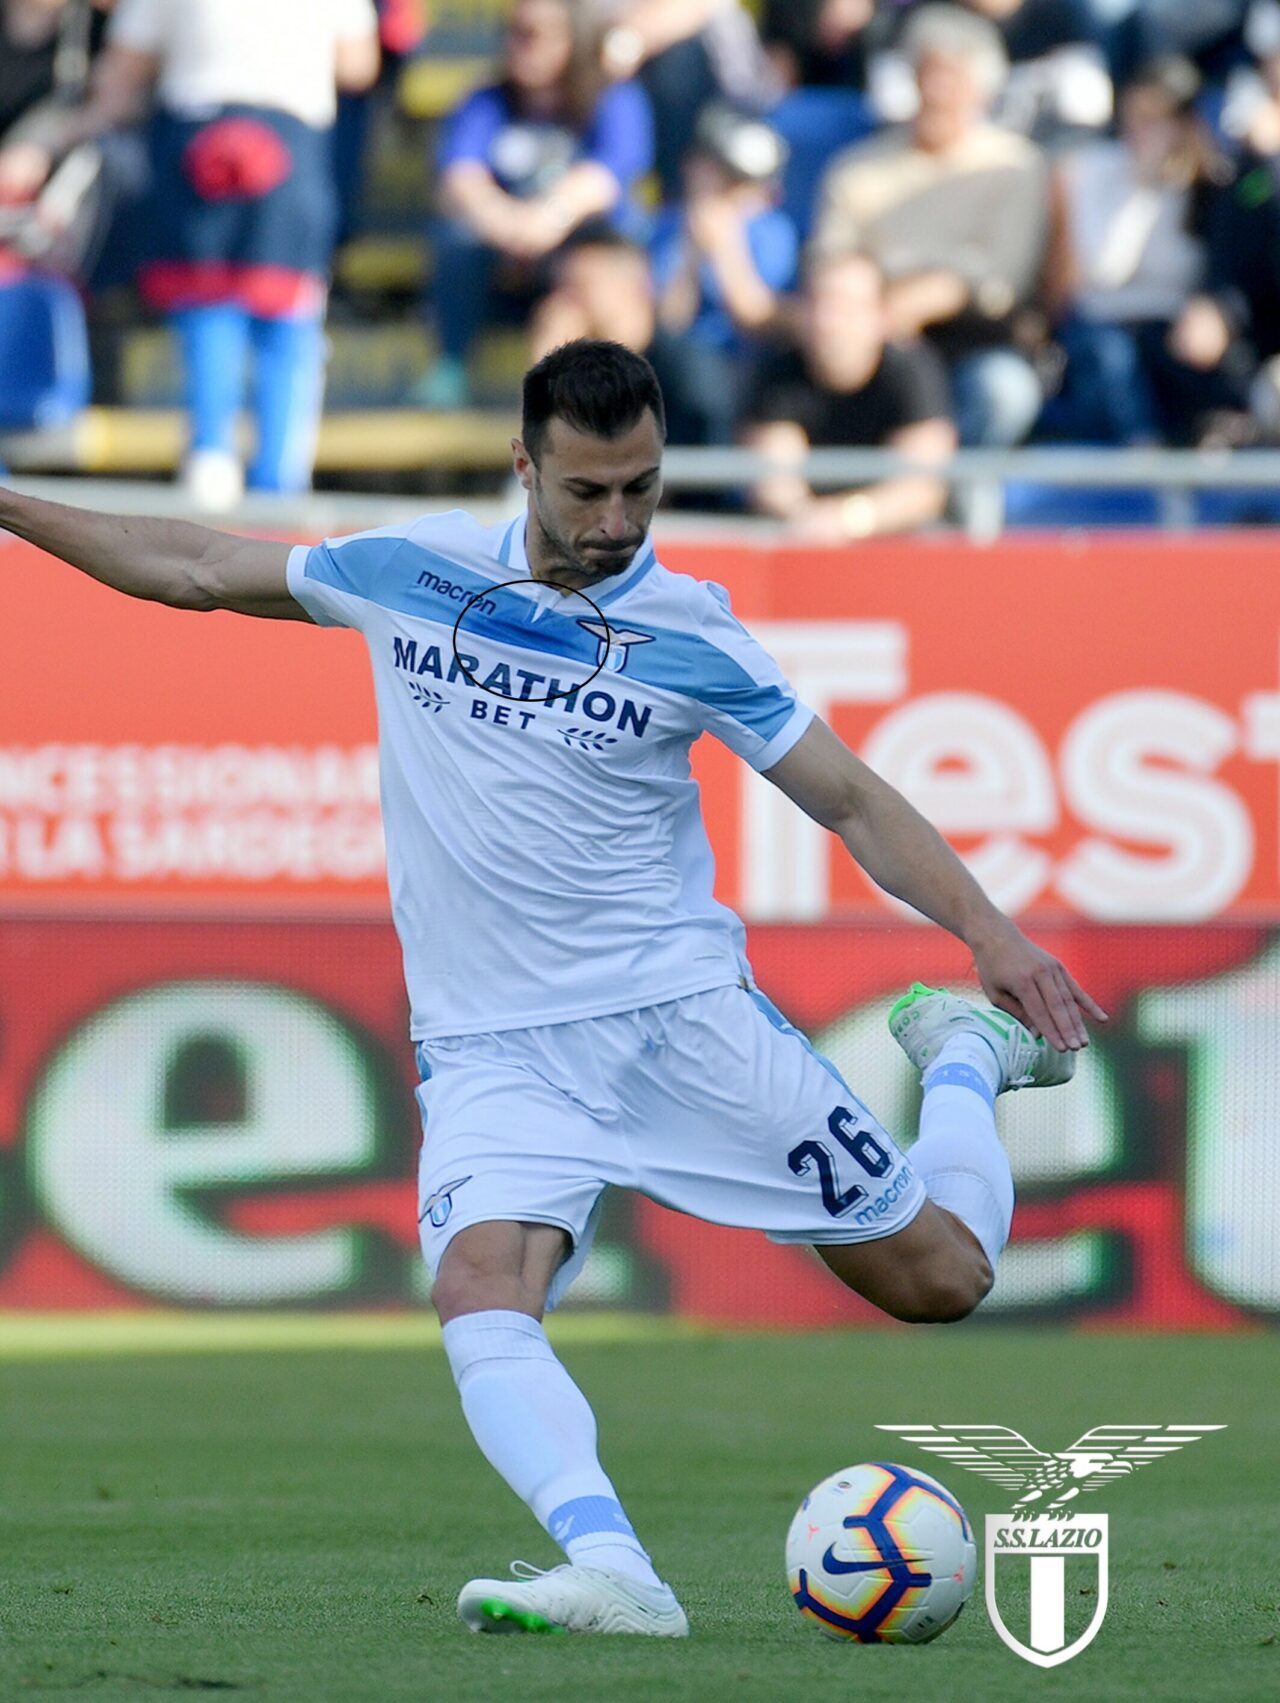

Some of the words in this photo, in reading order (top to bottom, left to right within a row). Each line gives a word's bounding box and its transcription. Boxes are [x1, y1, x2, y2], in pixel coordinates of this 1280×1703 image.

[417, 570, 497, 616] macron
[393, 637, 652, 738] MARATHON
[470, 700, 536, 730] BET
[787, 1105, 895, 1219] 26
[852, 1165, 914, 1226] macron
